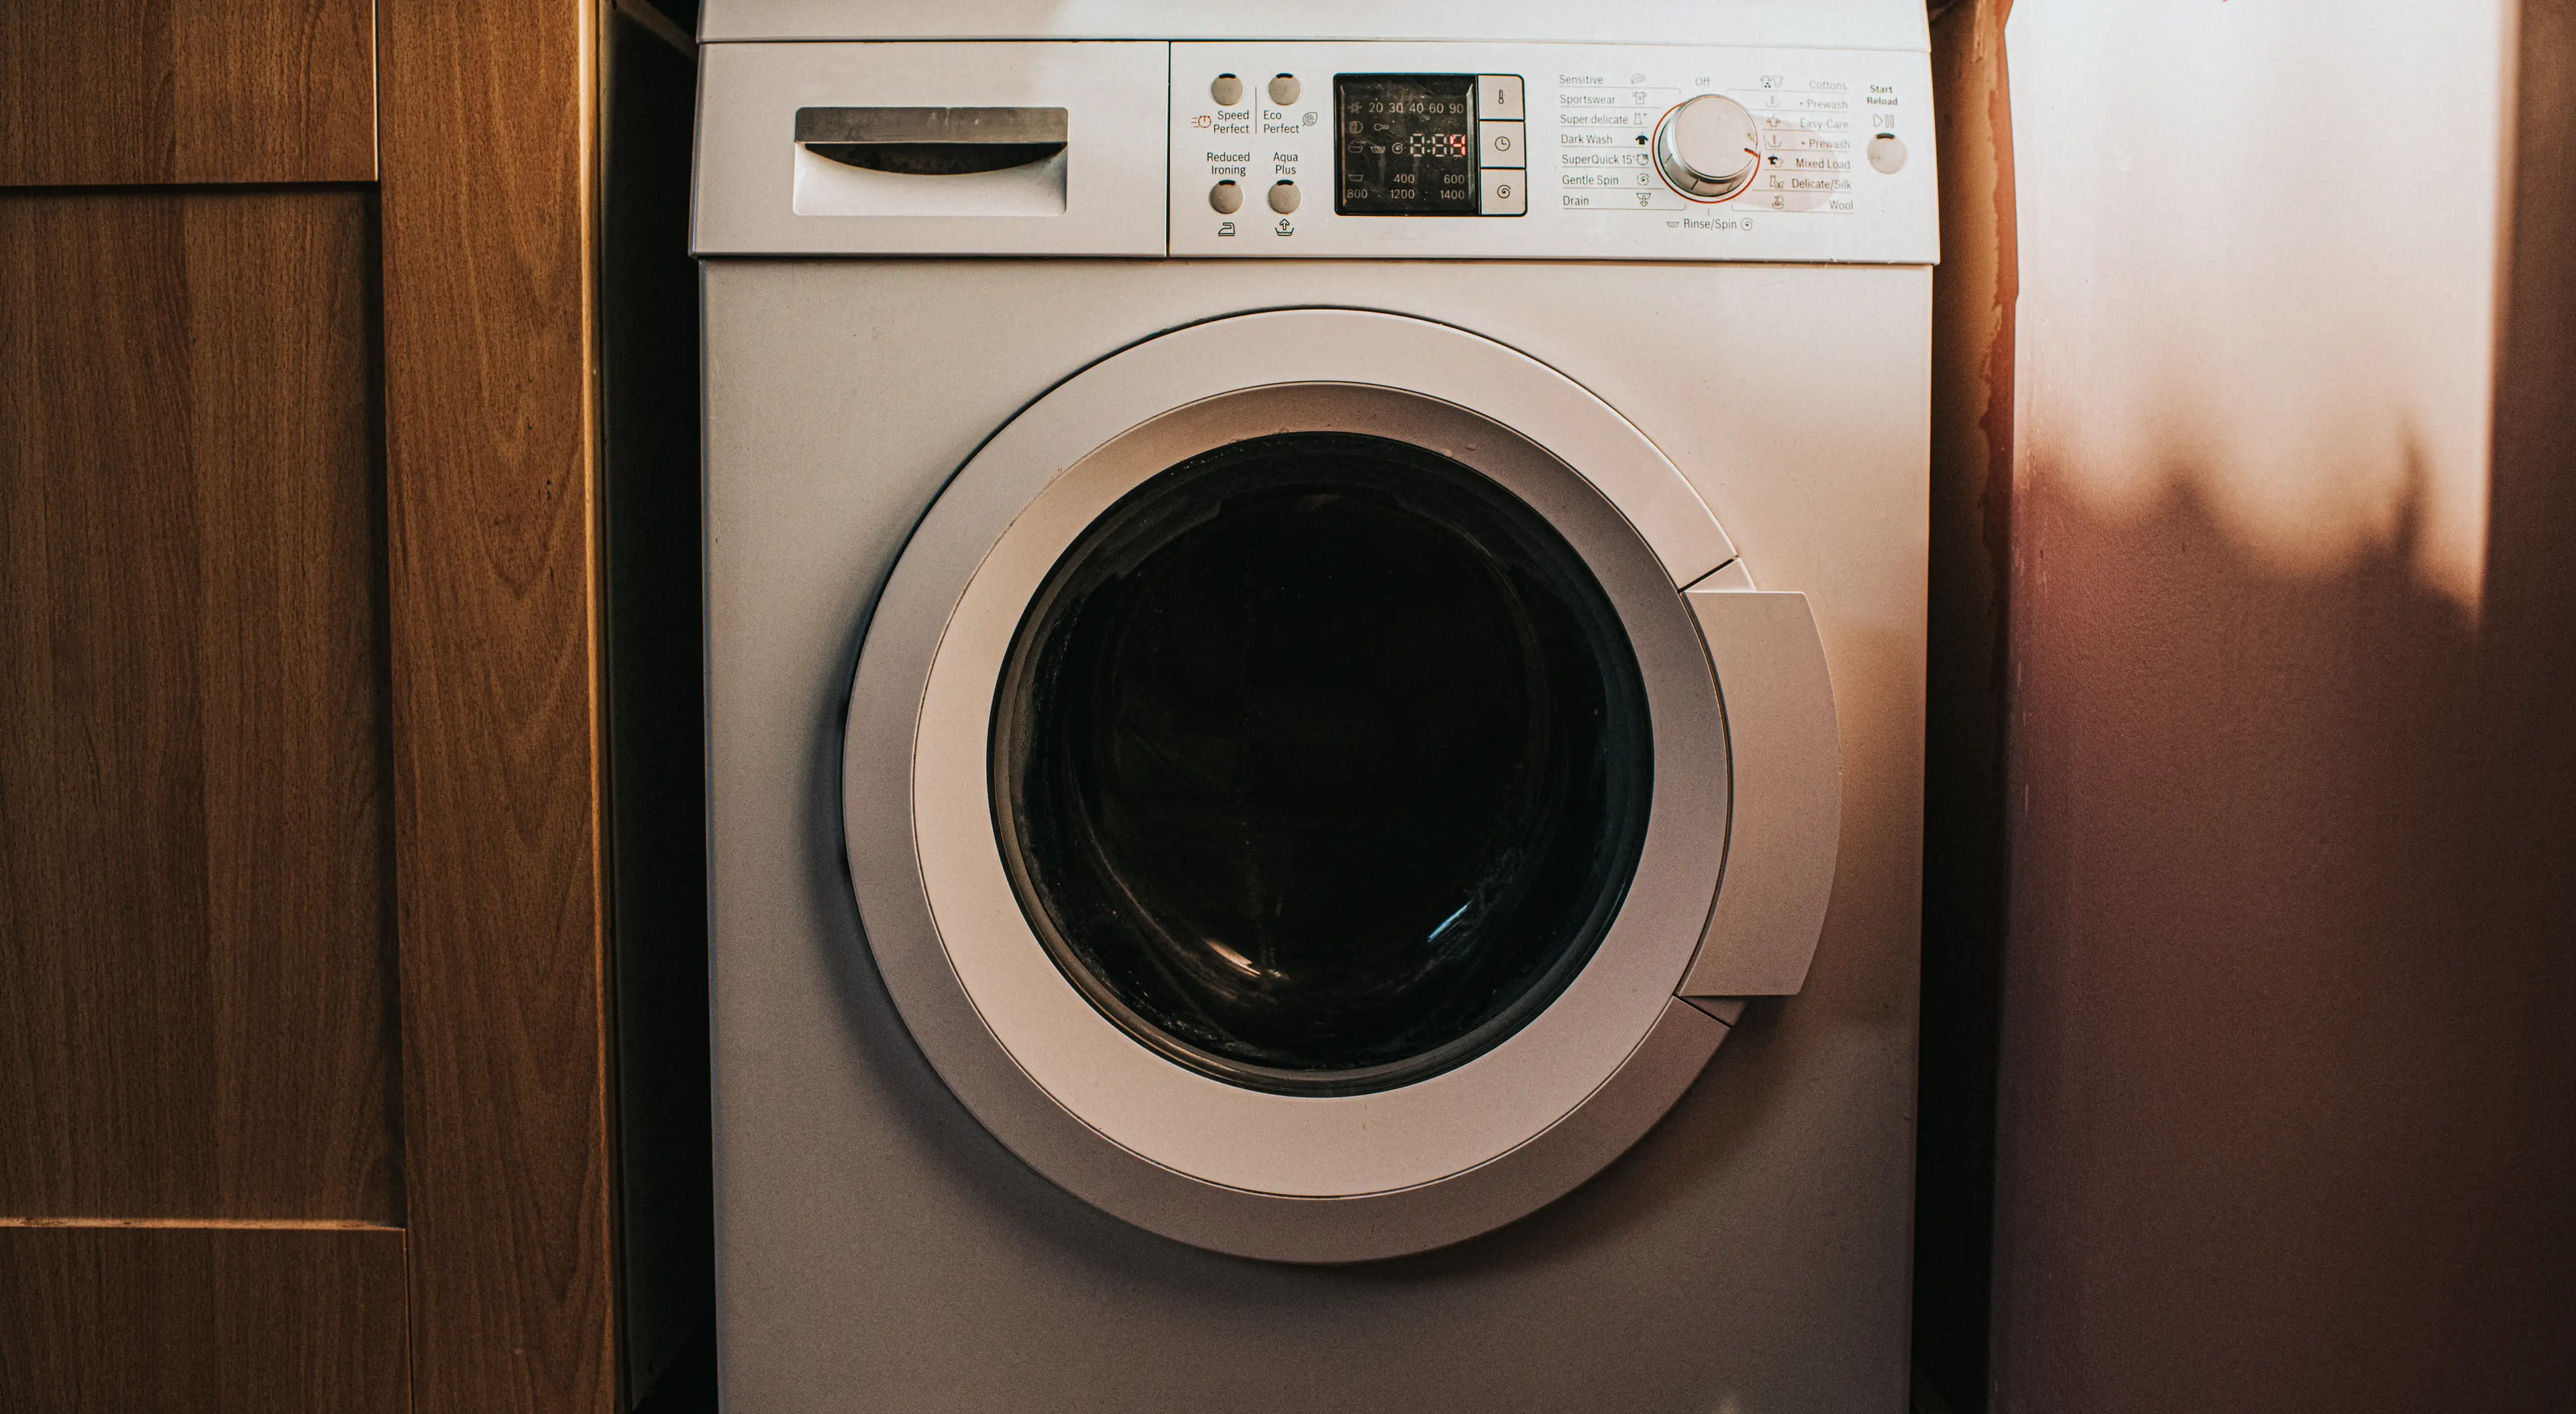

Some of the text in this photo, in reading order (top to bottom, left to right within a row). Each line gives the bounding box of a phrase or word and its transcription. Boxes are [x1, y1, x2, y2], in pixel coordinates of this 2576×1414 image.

[1559, 74, 1603, 85] Sensitive
[1695, 77, 1710, 87] Off
[1809, 80, 1847, 90] Cottons
[1870, 85, 1892, 93] Start
[1560, 95, 1615, 105] Sportswear
[1807, 100, 1848, 109] Prewash
[1867, 97, 1898, 105] Reload
[1368, 103, 1464, 113] 20 30 40 60 90
[1218, 110, 1249, 121] Speed
[1264, 110, 1282, 120] Eco
[1560, 114, 1628, 125] Super delicate
[1214, 124, 1249, 133] Perfect
[1264, 124, 1299, 133] Perfect
[1561, 134, 1613, 144] Dark Wash
[1809, 139, 1850, 149] Prewash
[1208, 152, 1250, 162] Reduced
[1273, 152, 1298, 164] Aqua
[1562, 154, 1619, 166] SuperQuick
[1796, 158, 1850, 169] Mixed Load
[1212, 165, 1246, 176] Ironing
[1275, 165, 1296, 174] Plus
[1394, 174, 1464, 184] 400 600
[1562, 174, 1619, 186] Gentle Spin
[1792, 178, 1851, 190] Delicate/Silk
[1347, 189, 1464, 200] 800 1200 1400
[1563, 195, 1589, 205] Drain
[1829, 200, 1854, 210] Wool
[1684, 218, 1737, 231] Rinse/Spin
